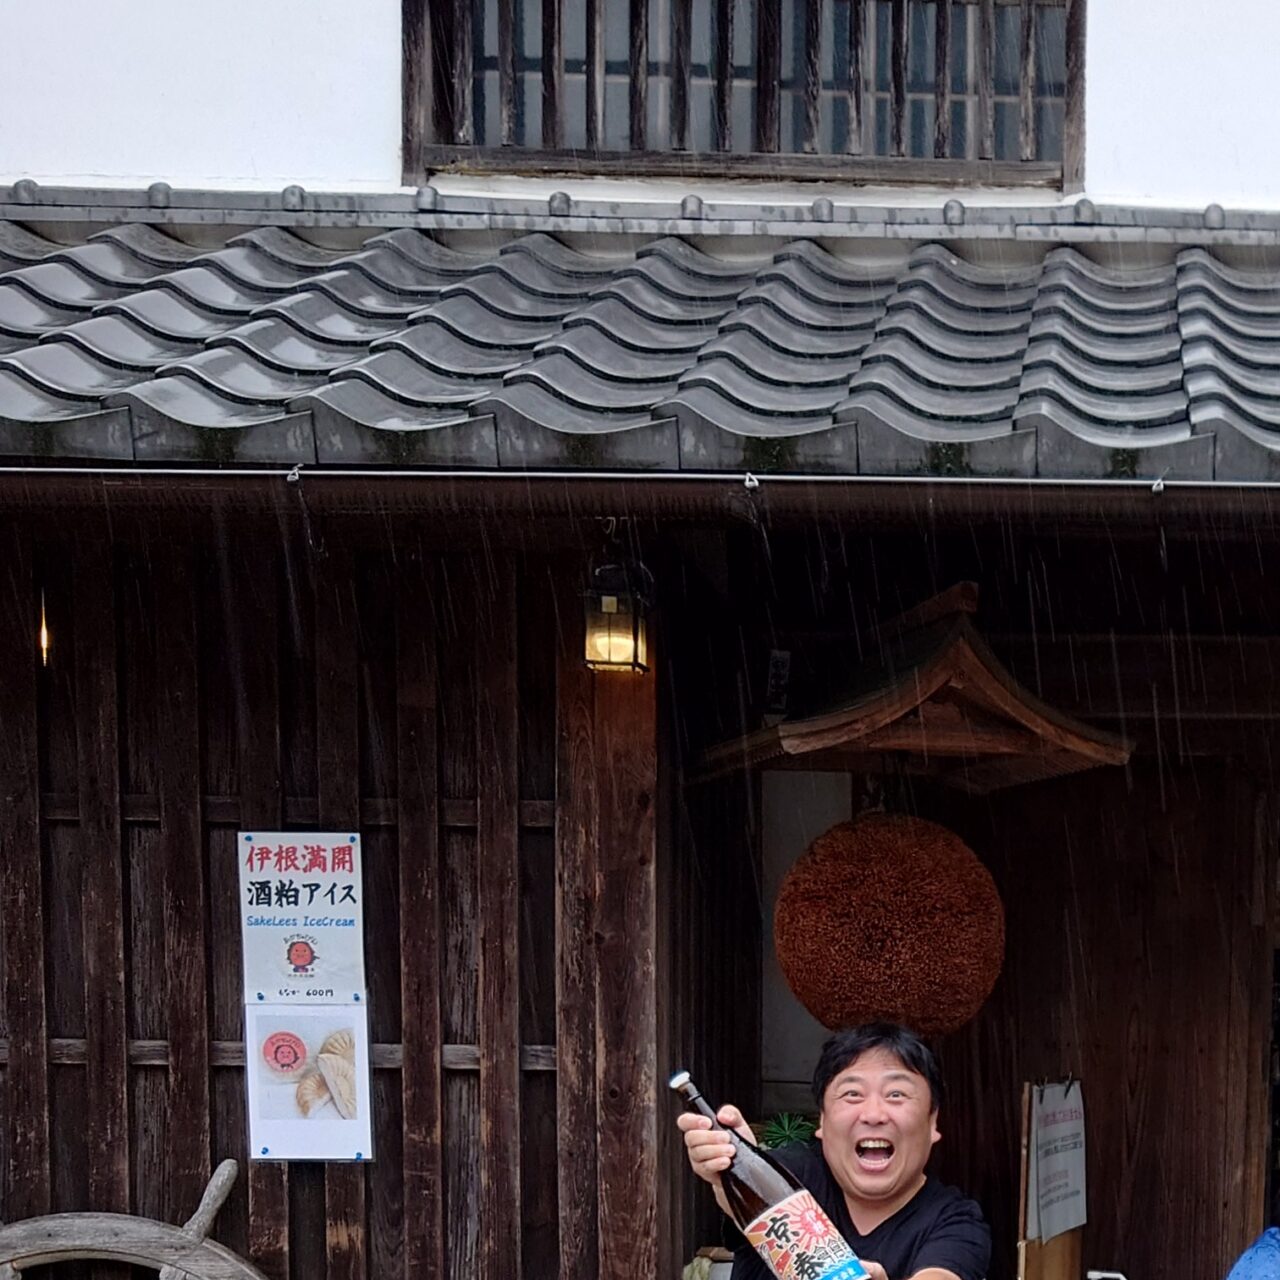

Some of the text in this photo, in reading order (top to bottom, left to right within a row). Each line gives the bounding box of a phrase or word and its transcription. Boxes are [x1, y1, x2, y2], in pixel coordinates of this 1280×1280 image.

[246, 844, 354, 874] 伊根満開
[247, 881, 357, 908] 酒粕アイス
[247, 915, 356, 927] SakeLees IceCream
[306, 989, 334, 997] 600円
